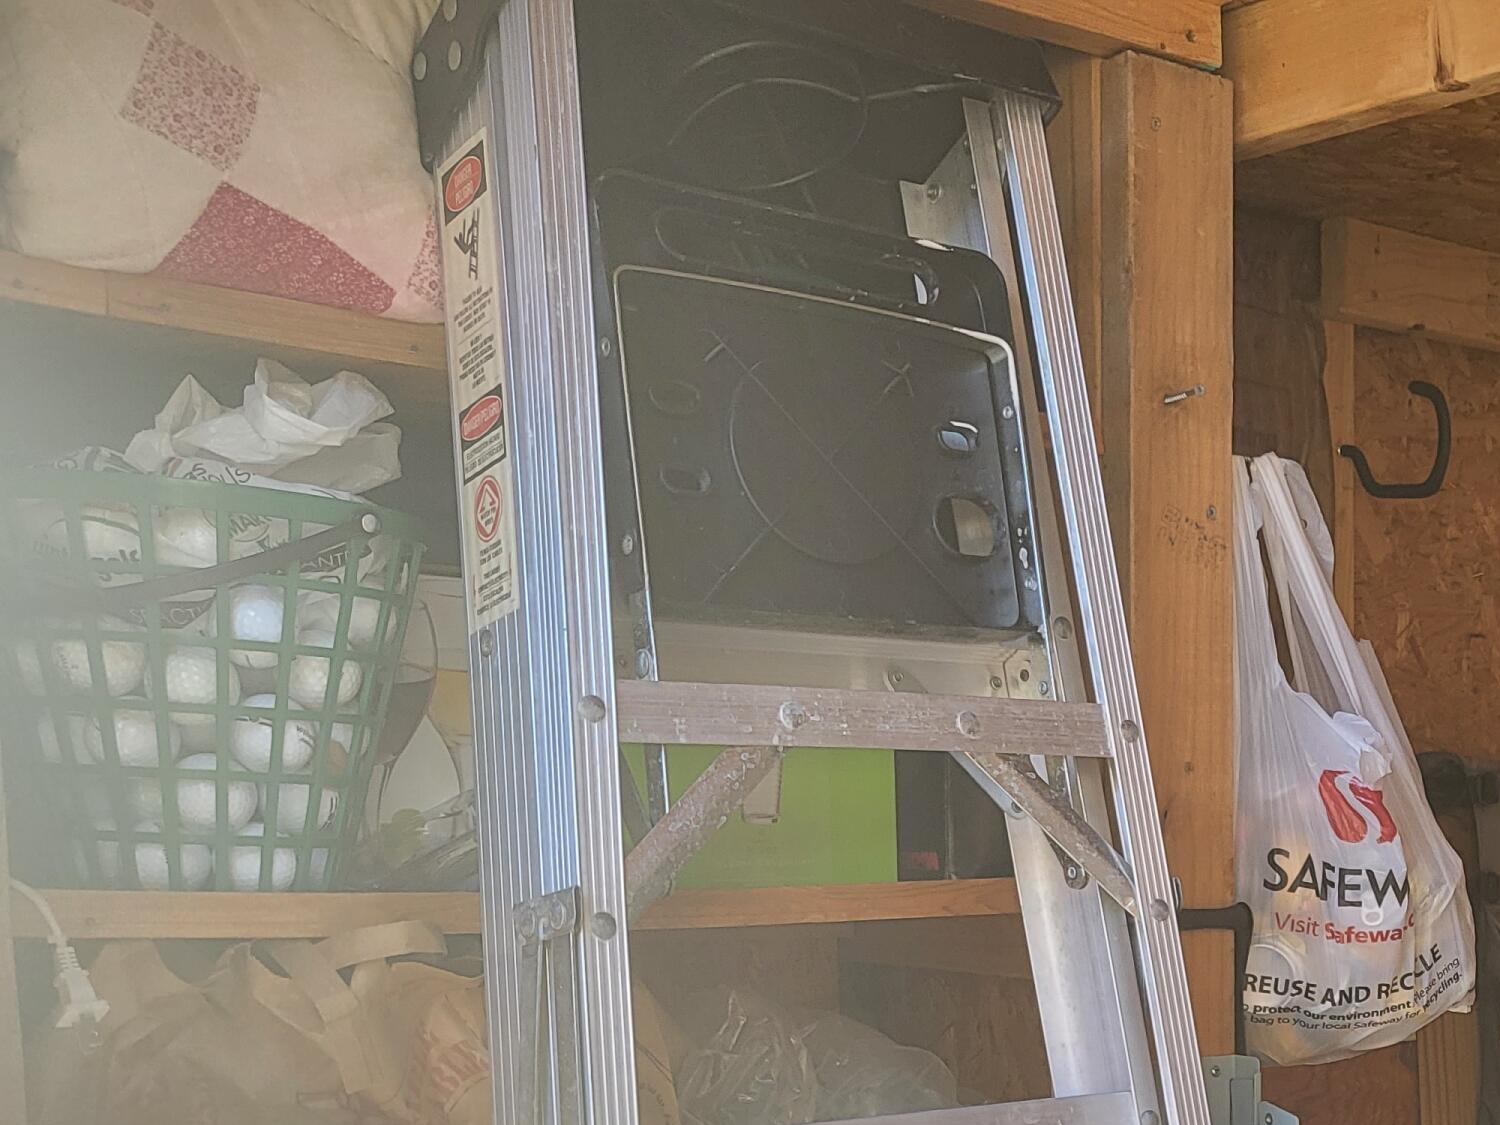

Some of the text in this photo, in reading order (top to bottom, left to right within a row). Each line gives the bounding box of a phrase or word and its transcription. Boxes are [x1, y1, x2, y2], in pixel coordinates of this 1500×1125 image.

[1275, 911, 1320, 938] Visit
[1244, 943, 1443, 1007] REUSE AND RECCLE
[1253, 1003, 1302, 1014] protect
[1303, 1010, 1327, 1021] our
[1436, 957, 1460, 981] bring
[1250, 1014, 1275, 1026] bag
[1277, 1015, 1290, 1025] to
[1291, 1017, 1321, 1031] your
[1322, 1019, 1351, 1030] local
[1354, 1013, 1403, 1030] Safeway
[1405, 1008, 1422, 1020] for
